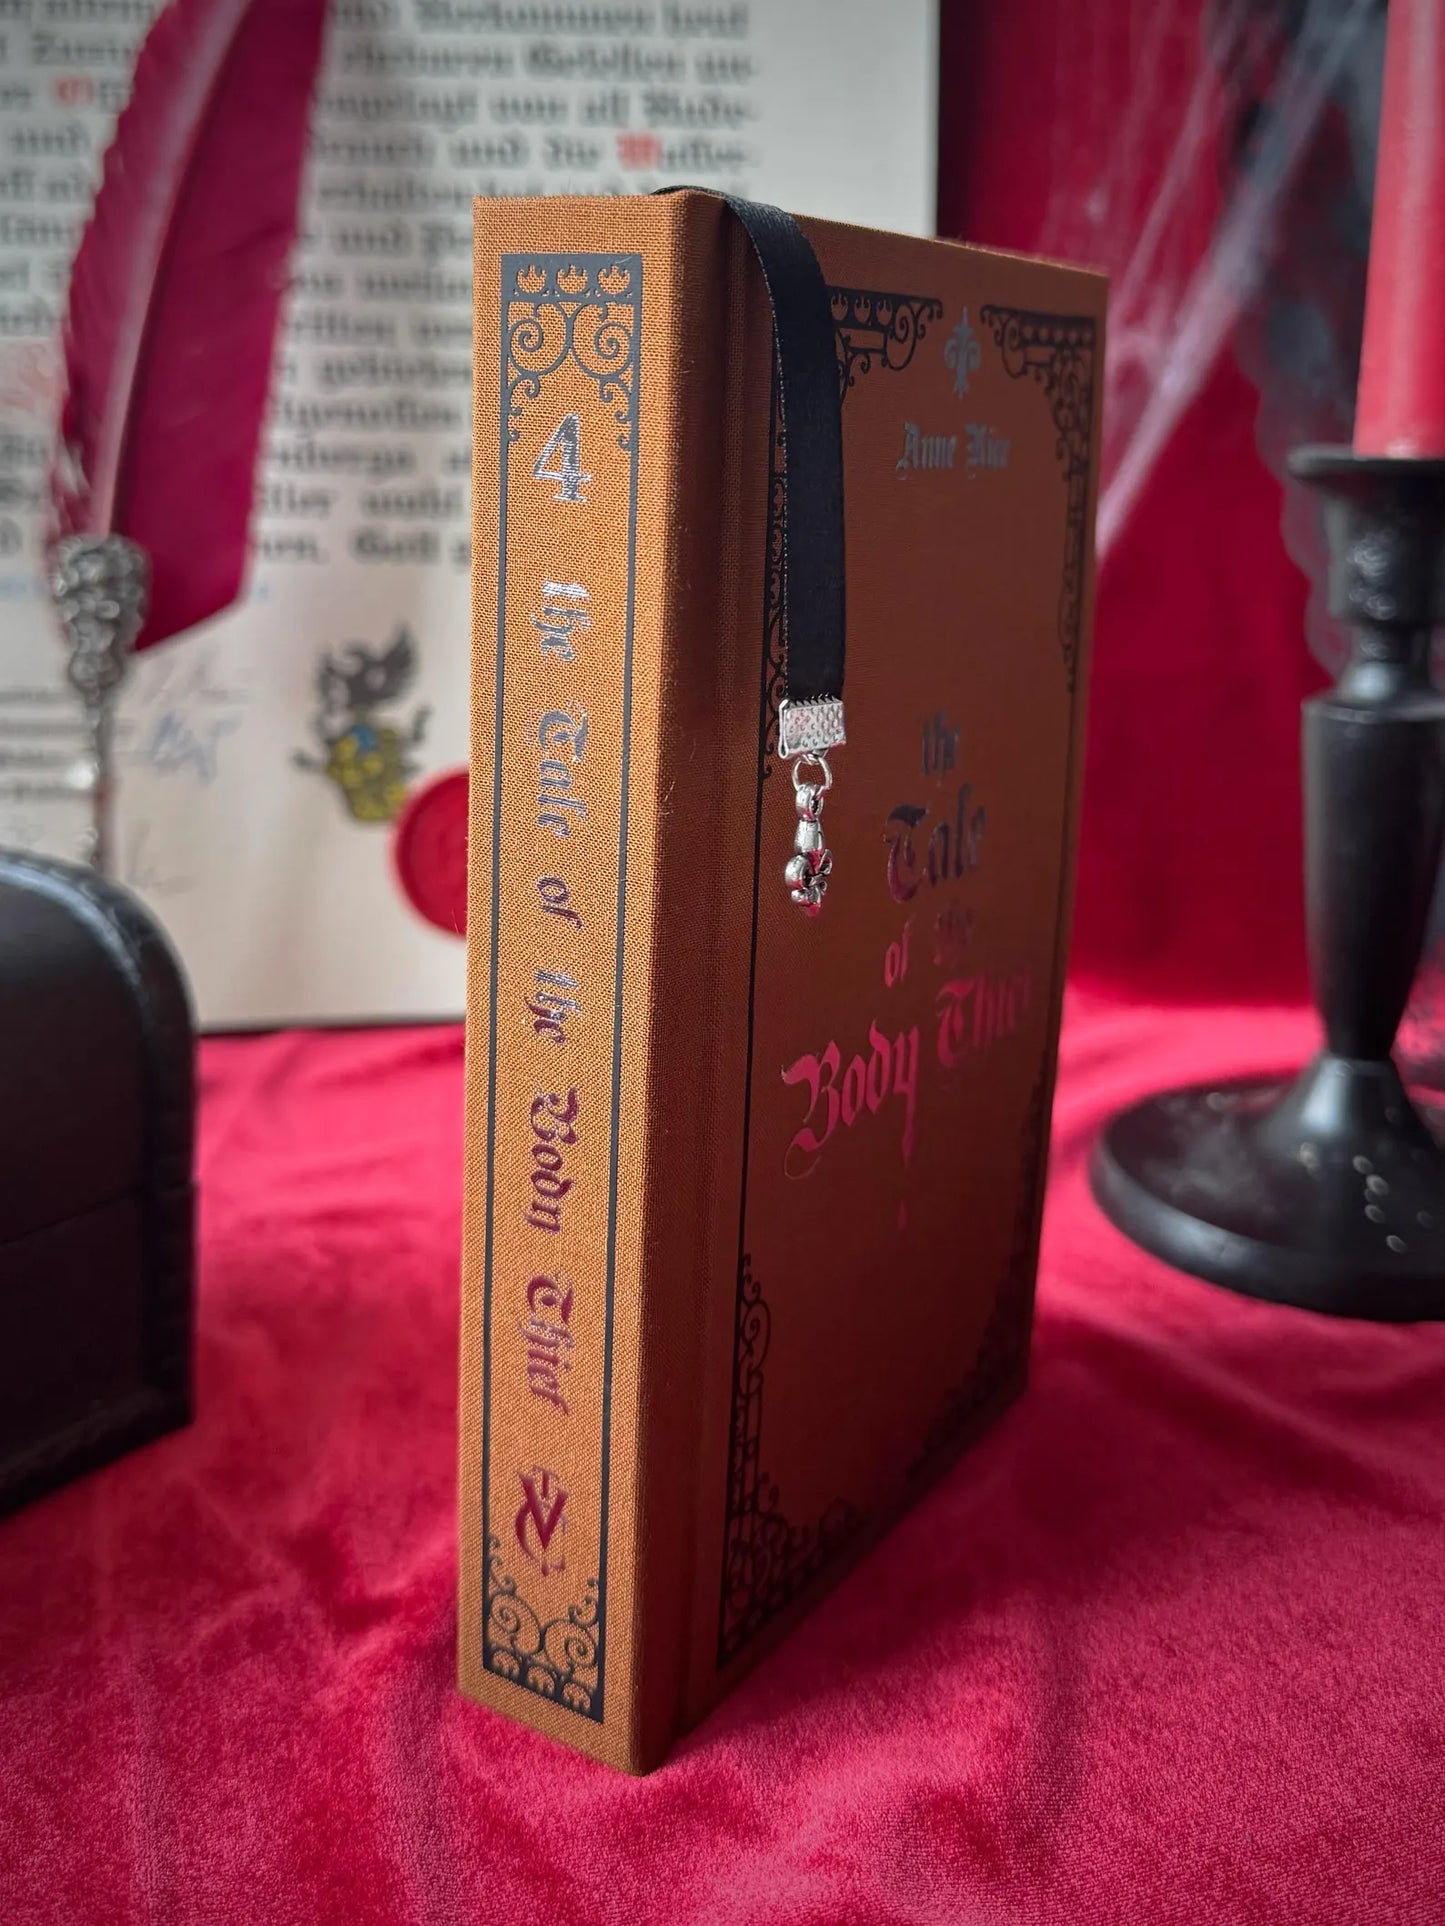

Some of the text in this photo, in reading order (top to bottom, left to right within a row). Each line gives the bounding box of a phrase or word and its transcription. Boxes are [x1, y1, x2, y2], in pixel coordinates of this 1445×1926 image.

[533, 412, 592, 502] 4
[896, 420, 958, 481] Anne
[528, 701, 590, 838] Tale
[535, 875, 583, 932] of
[526, 1086, 580, 1235] Body
[781, 1020, 920, 1181] Body
[517, 1273, 574, 1415] Thief
